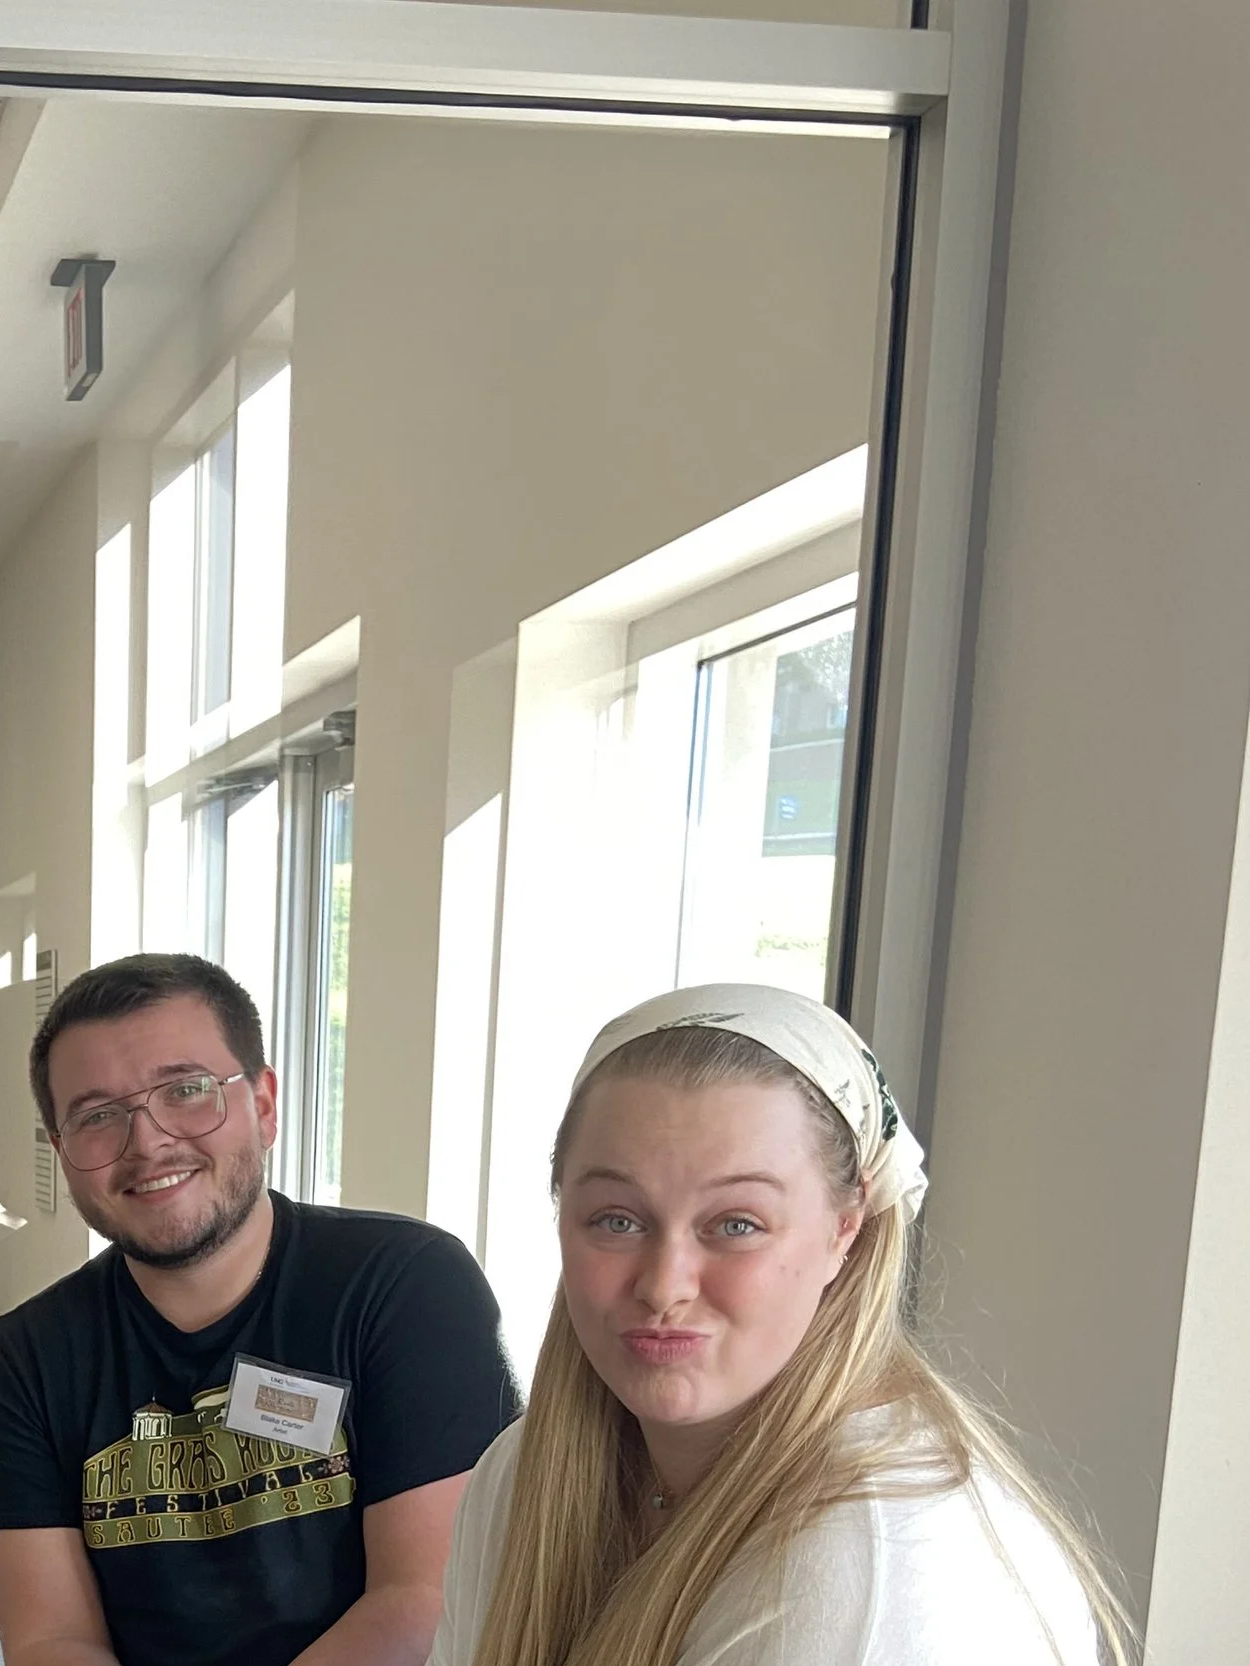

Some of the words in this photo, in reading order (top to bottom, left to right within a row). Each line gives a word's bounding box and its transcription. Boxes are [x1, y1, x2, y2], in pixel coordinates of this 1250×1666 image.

[83, 1445, 133, 1499] THE
[147, 1431, 227, 1492] GRAS
[105, 1464, 313, 1519] FESTIVAL
[92, 1507, 236, 1545] SAUTEE
